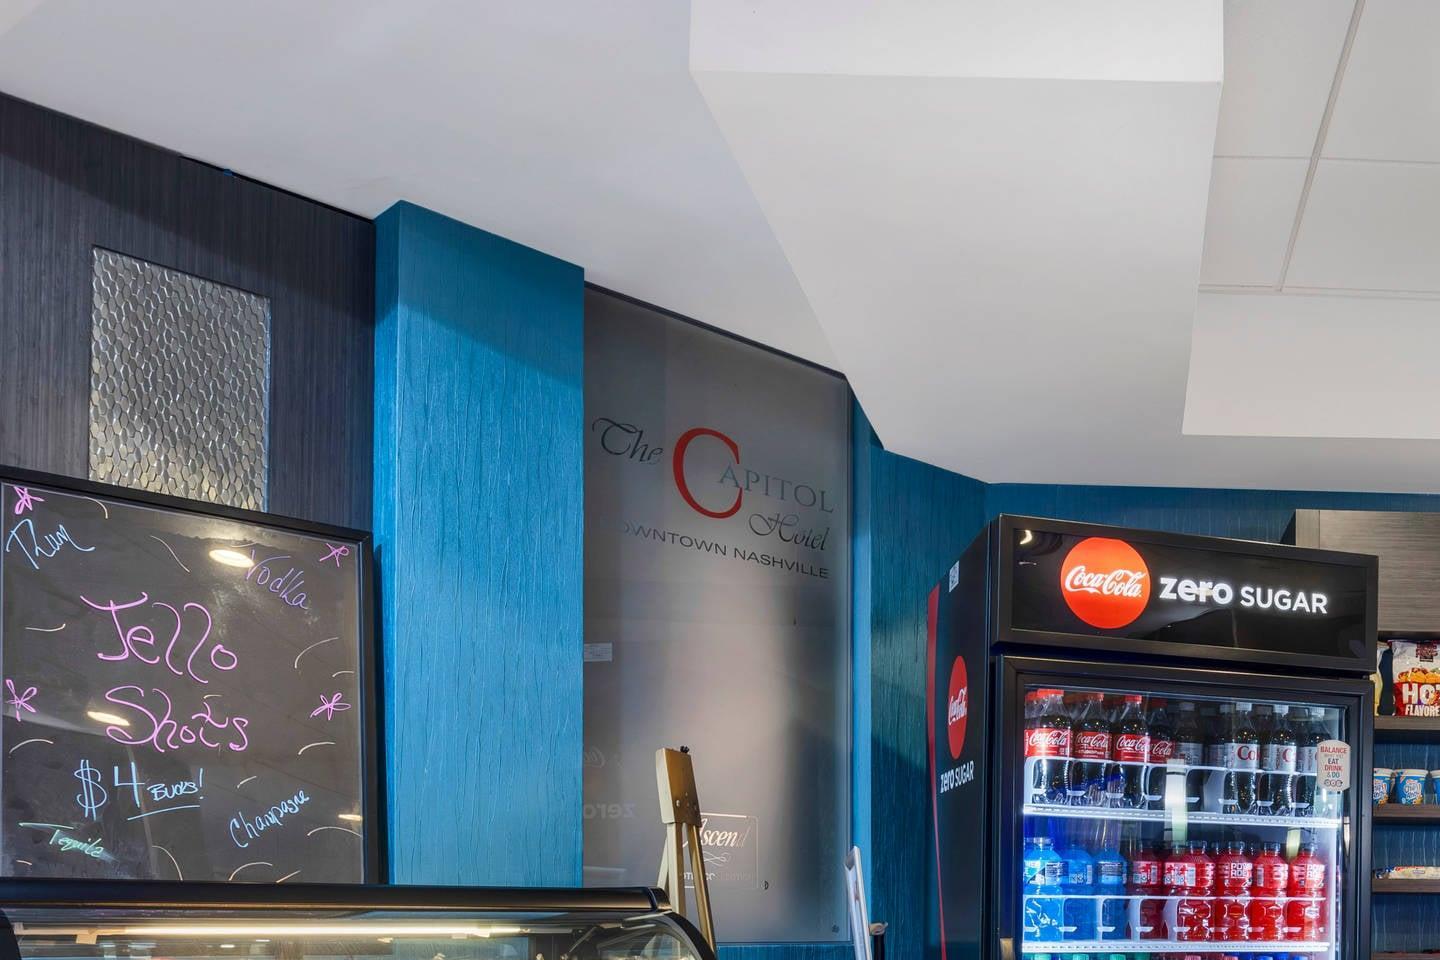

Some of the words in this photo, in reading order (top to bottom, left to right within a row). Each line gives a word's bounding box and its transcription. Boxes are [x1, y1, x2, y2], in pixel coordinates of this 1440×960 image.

[592, 418, 663, 464] The
[673, 427, 833, 519] CAPITOL
[6, 518, 96, 570] Rum
[616, 519, 727, 555] OWNTOWN
[734, 547, 830, 579] NASHVILLE
[749, 513, 830, 550] Hotel
[242, 550, 307, 609] Vodka
[1065, 565, 1147, 598] Coca-Cola
[1160, 574, 1233, 604] zero
[1240, 586, 1328, 615] SUGAR
[80, 592, 238, 683] Jello
[106, 686, 249, 752] Shots
[940, 774, 954, 794] zero
[955, 760, 974, 787] SUGAR
[1320, 745, 1347, 754] BALANCE
[228, 790, 310, 848] Champagne
